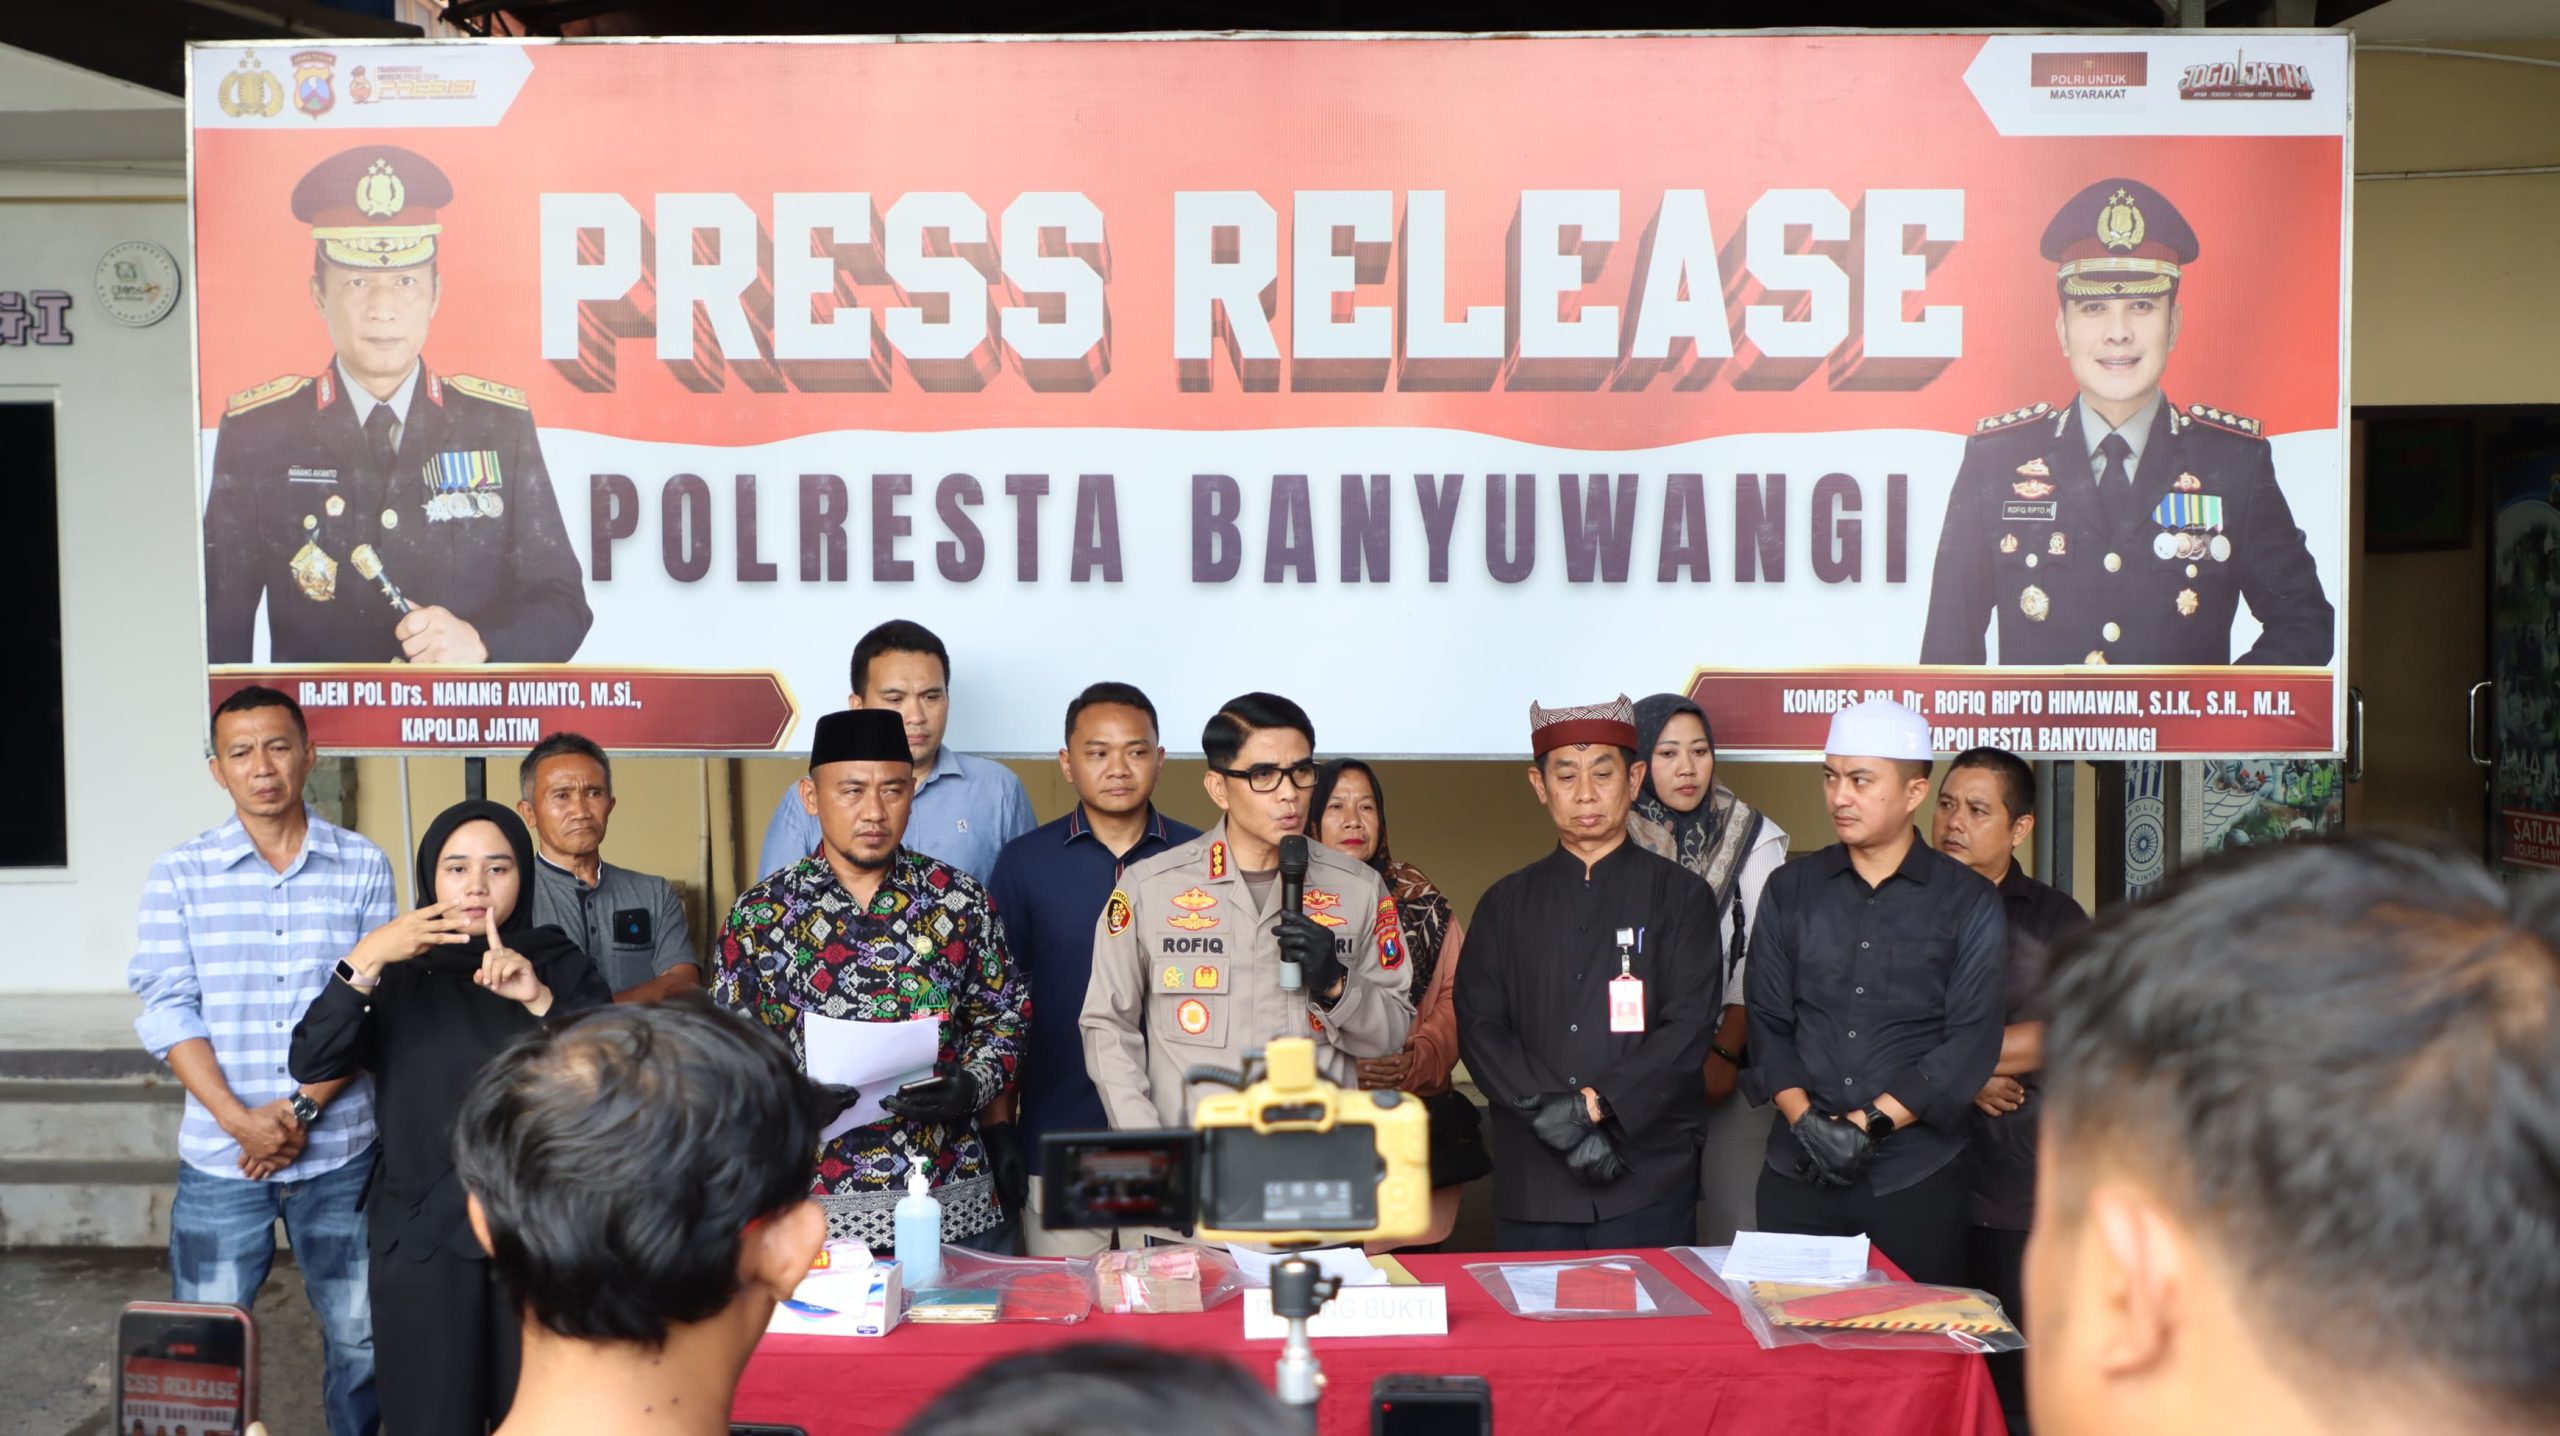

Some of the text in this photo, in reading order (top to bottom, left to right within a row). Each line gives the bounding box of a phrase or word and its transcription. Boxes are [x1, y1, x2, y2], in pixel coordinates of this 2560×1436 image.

[2050, 74, 2127, 85] POLRI UNTUK
[2178, 62, 2313, 92] JOGO JATIM
[2049, 88, 2127, 100] MASYARAKAT
[539, 188, 1966, 362] PRESS RELEASE
[589, 473, 1909, 584] POLRESTA BANYUWANGI
[299, 681, 642, 709] IRJEN POL Drs. NANANG AVIANTO, M.Si.,
[1783, 689, 1858, 714] KOMBES
[1903, 689, 1929, 714] Dr.
[1935, 690, 1986, 716] ROFIQ
[1991, 690, 2043, 715] RIPTO
[2048, 690, 2144, 717] HIMAWAN,
[2149, 690, 2201, 718] S.I.K.,
[2206, 690, 2248, 718] S.H.,
[2253, 691, 2295, 715] M.H.
[401, 717, 539, 742] KAPOLDA JATIM
[1928, 726, 2157, 752] APOLRESTA BANYUWANGI
[2128, 804, 2164, 818] POLIS
[1163, 937, 1224, 954] ROFIQ
[1255, 1298, 1434, 1319] BNG BUKTI
[165, 1377, 237, 1400] RELEASE
